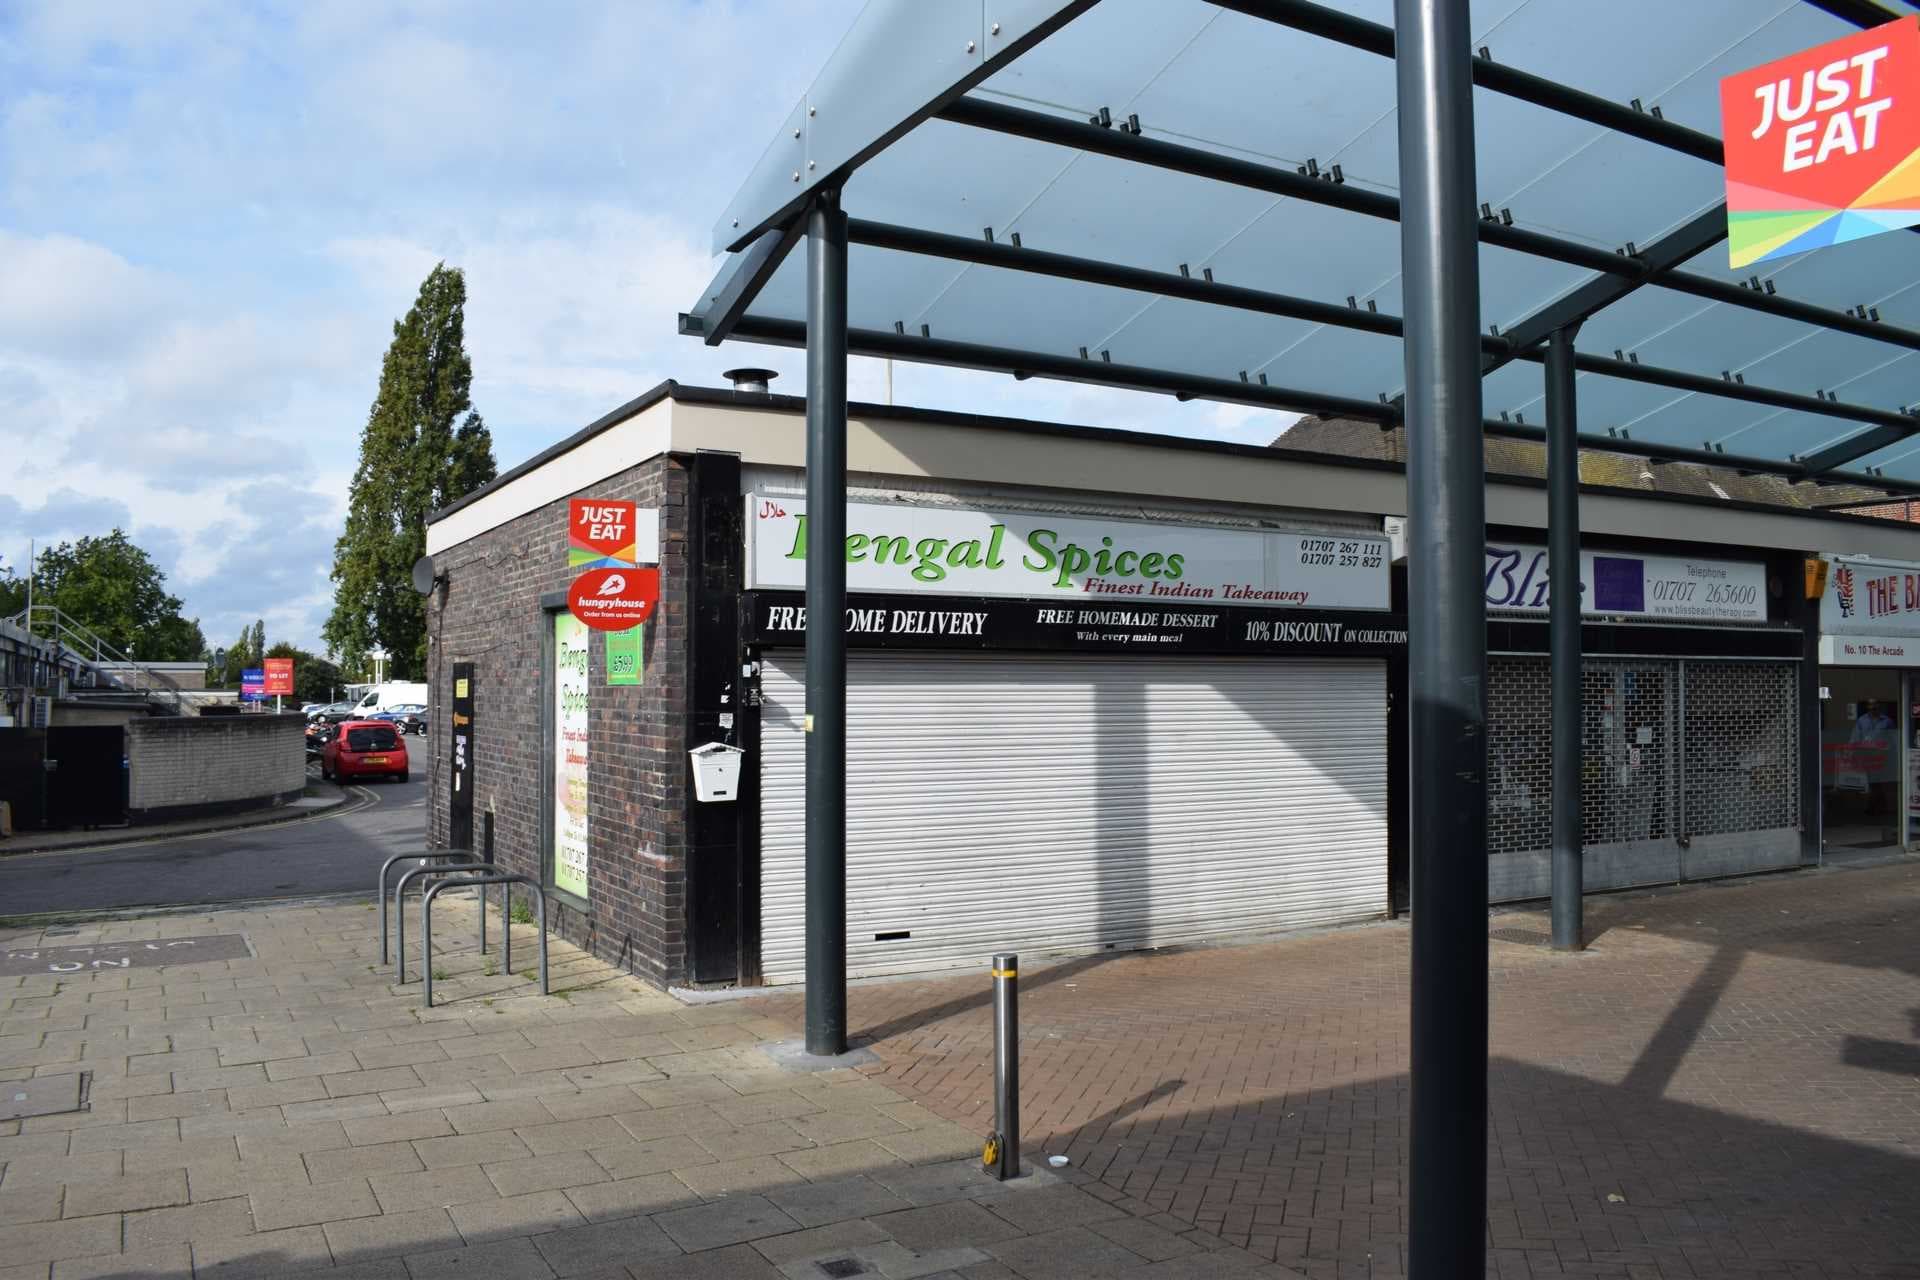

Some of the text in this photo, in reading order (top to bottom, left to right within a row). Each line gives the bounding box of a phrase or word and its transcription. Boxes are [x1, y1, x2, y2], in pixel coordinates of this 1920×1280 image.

[1752, 46, 1888, 140] JUST
[1783, 97, 1892, 173] EAT
[579, 506, 626, 525] JUST
[759, 501, 787, 519] حلال
[589, 524, 626, 540] EAT
[1300, 540, 1382, 556] 01707 267 111
[1023, 529, 1185, 588] Spices
[1300, 552, 1382, 568] 01707 257 827
[1686, 564, 1728, 579] Telephone
[1082, 577, 1309, 605] Finest Indian Takeaway
[1653, 580, 1697, 601] 01707
[1705, 583, 1757, 605] 265600
[1866, 575, 1899, 618] THE
[578, 597, 646, 609] hungryhouse
[766, 606, 988, 635] FRE OME DELIVERY
[1036, 609, 1219, 628] FREE HOMEMADE DESSERT
[1076, 631, 1183, 644] With every main meal
[1244, 621, 1409, 644] 10% DISCOUNT ON COLLECTION
[1844, 645, 1857, 655] No.
[1868, 646, 1881, 656] The
[1882, 646, 1904, 656] Arcade
